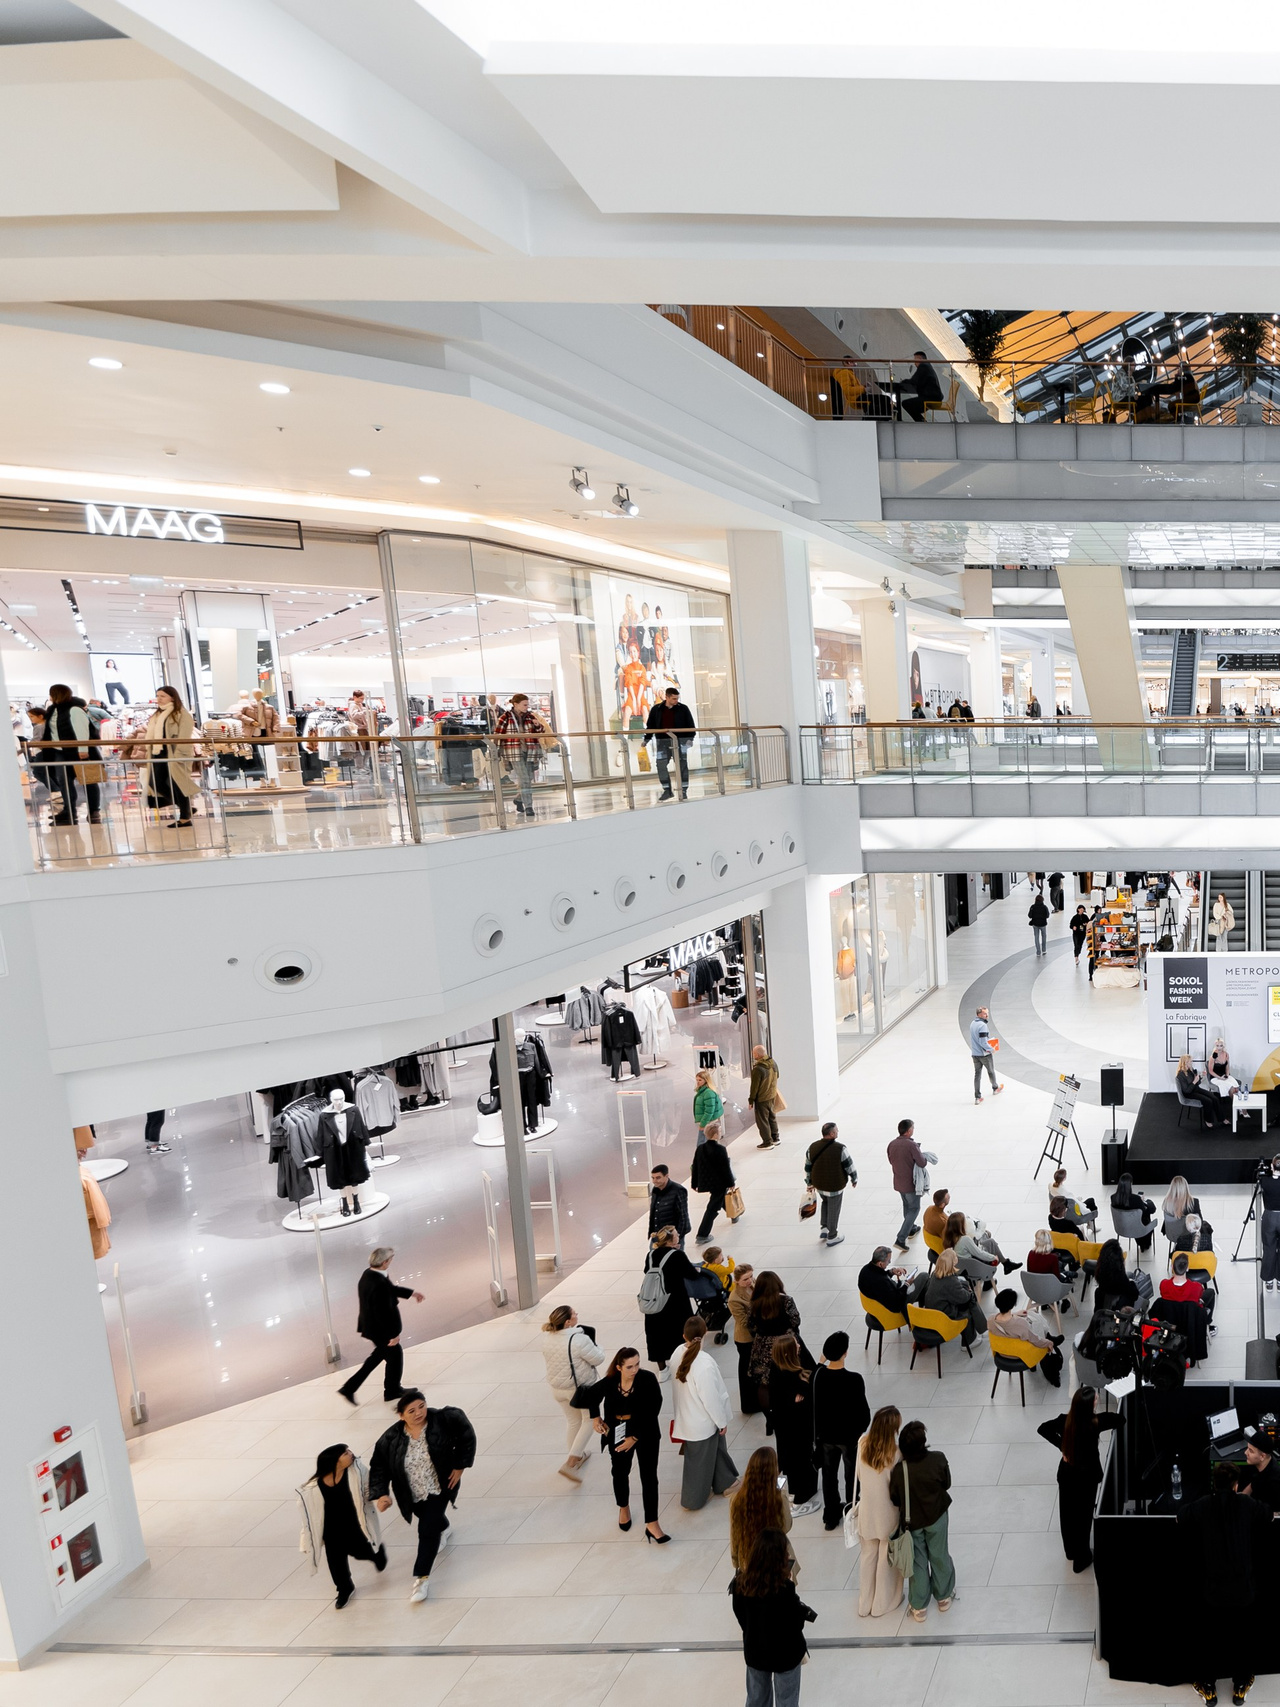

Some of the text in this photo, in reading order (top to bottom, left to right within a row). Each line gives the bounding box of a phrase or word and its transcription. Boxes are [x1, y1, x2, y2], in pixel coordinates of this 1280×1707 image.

[84, 503, 225, 544] MAAG
[1217, 654, 1228, 671] 2
[668, 931, 716, 972] MAAG
[1168, 976, 1203, 985] SOKOL
[1169, 987, 1204, 995] FASHION
[1169, 996, 1194, 1004] WEEK
[1165, 1013, 1208, 1022] La Fabrique
